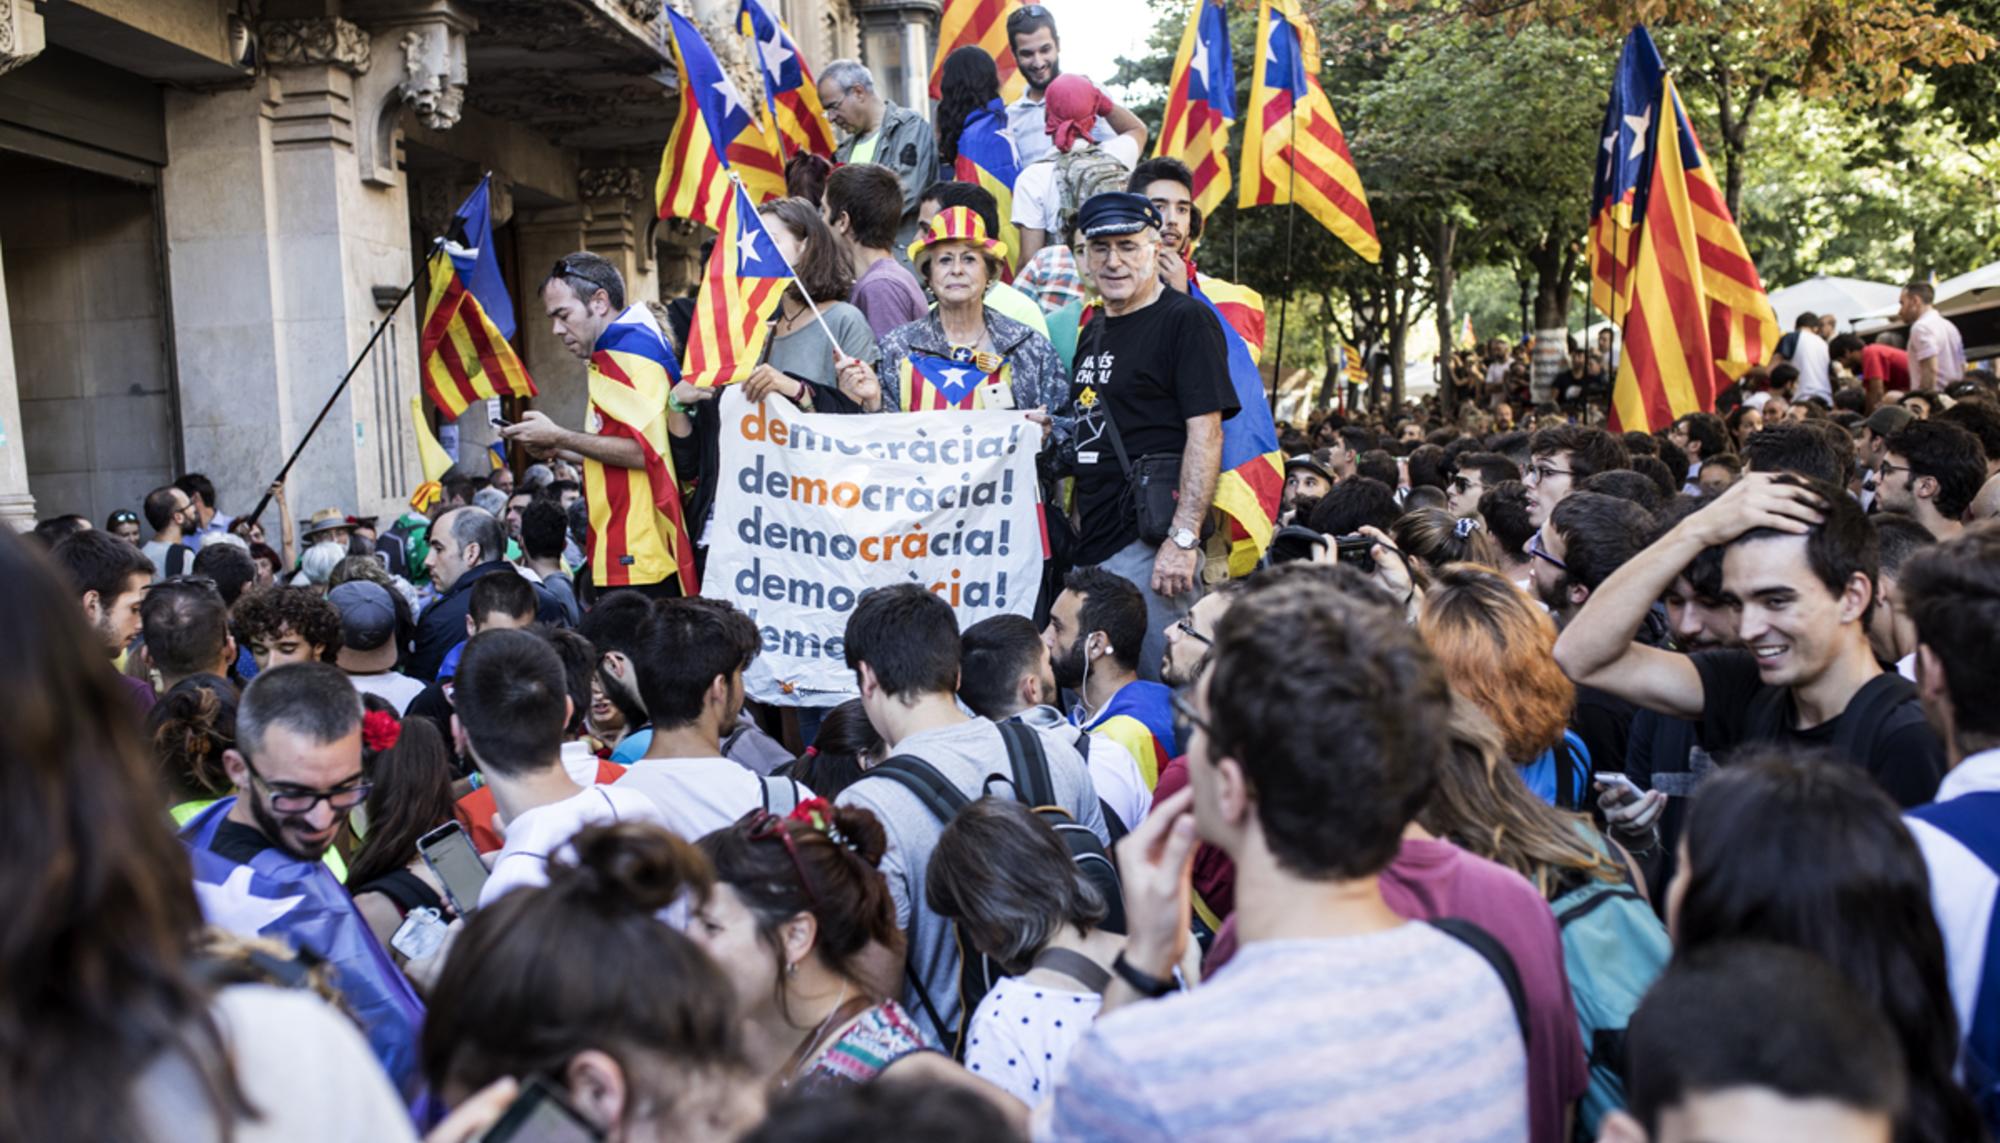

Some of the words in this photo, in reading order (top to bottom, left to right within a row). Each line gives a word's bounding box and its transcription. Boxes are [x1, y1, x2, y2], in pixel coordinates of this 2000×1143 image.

[738, 454, 1014, 512] democràcia!
[738, 506, 1010, 562] democràcia!
[735, 558, 1007, 612] demoia!
